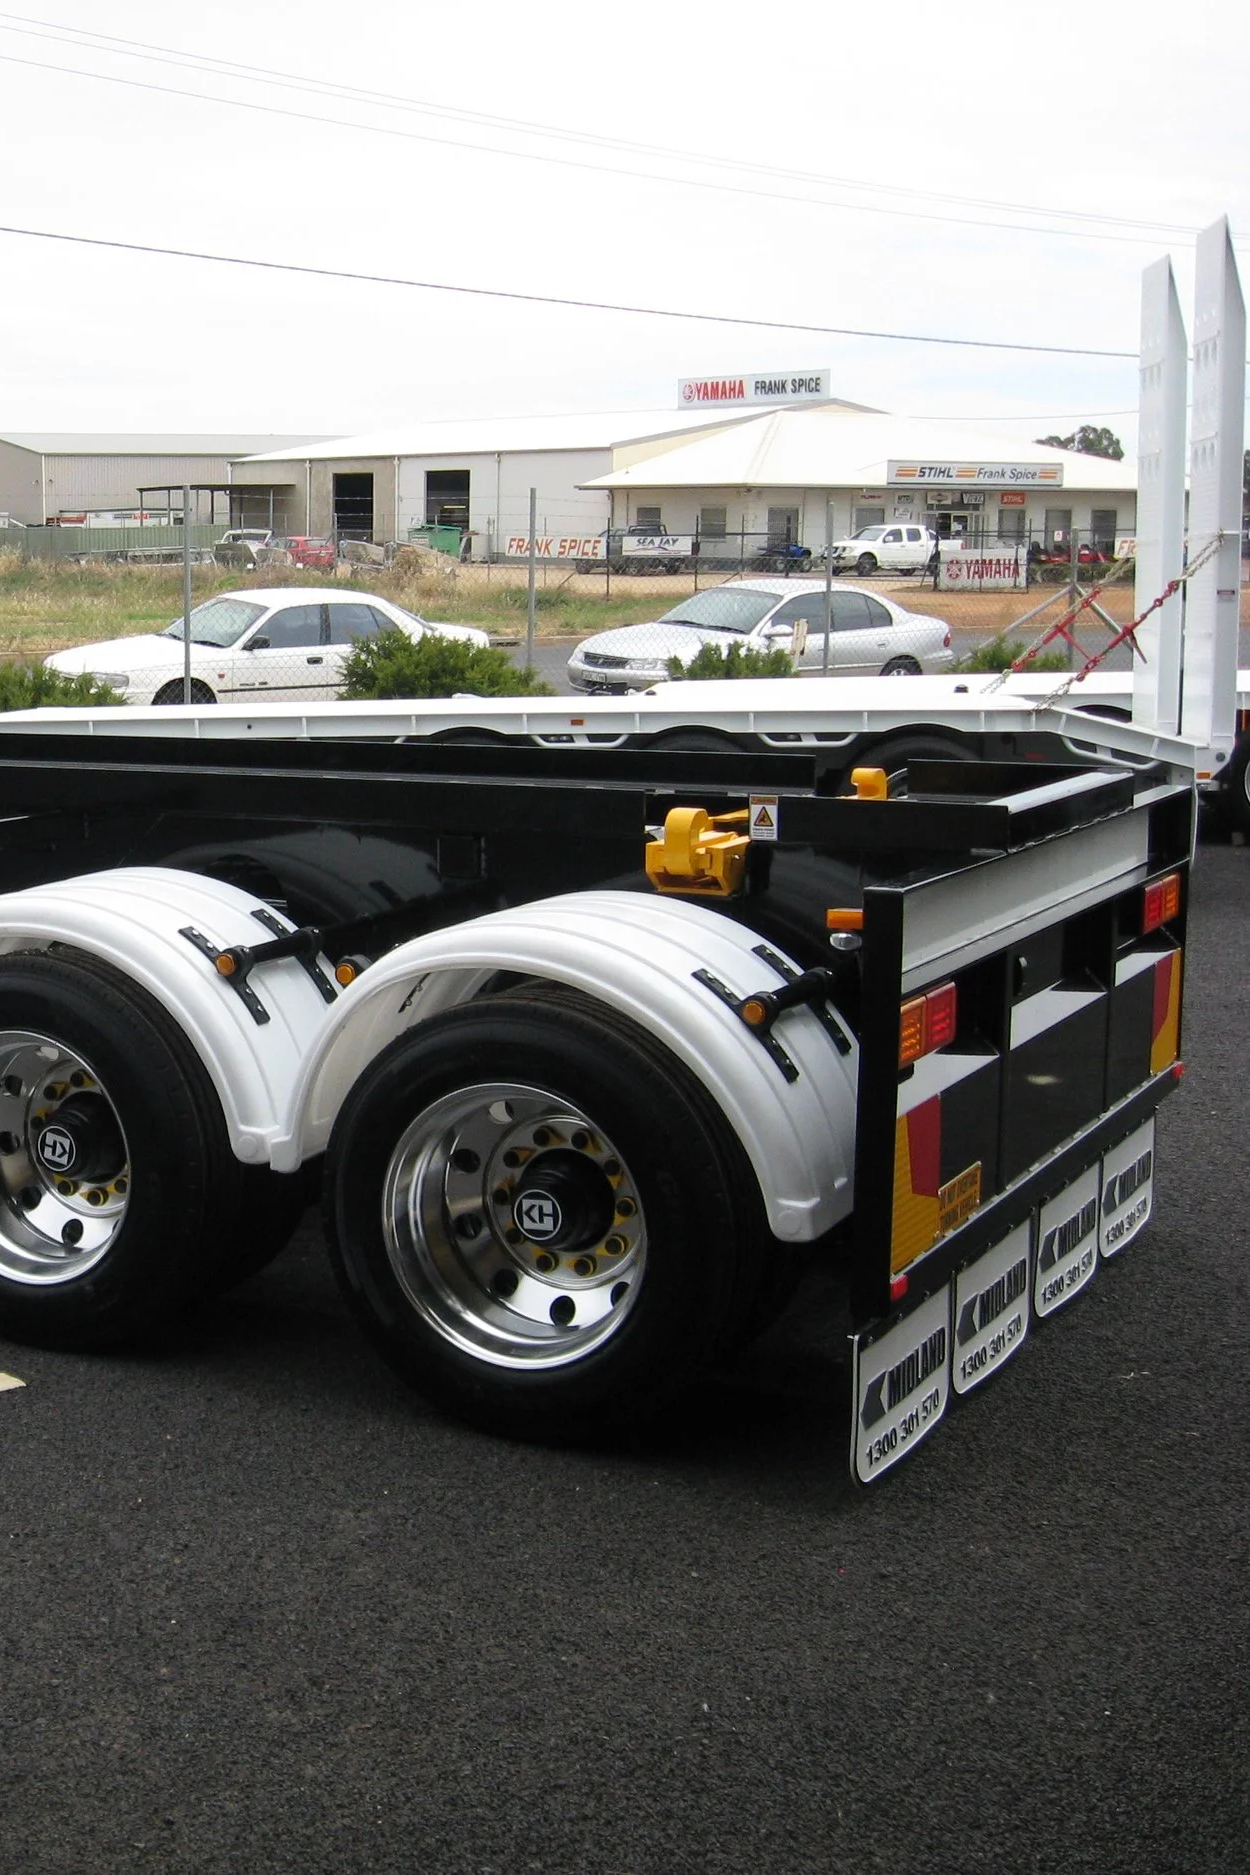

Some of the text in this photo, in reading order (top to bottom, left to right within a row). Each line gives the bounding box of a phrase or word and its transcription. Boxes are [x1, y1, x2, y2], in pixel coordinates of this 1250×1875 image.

[695, 377, 821, 401] YAMAHA FRANK SPICE
[917, 466, 1037, 482] STIHL Frank Spice
[558, 539, 602, 557] SPICE
[636, 537, 655, 547] SEA
[965, 558, 1020, 580] YAMAHA
[1119, 1150, 1152, 1206] MIDLAND
[1057, 1198, 1096, 1261] MIDLAND
[978, 1258, 1027, 1331] MIDLAND
[1042, 1274, 1065, 1305] 1300
[888, 1326, 946, 1413] MIDLAND
[960, 1345, 988, 1379] 1300
[989, 1328, 1006, 1358] 301
[865, 1387, 940, 1469] 1300 301 570
